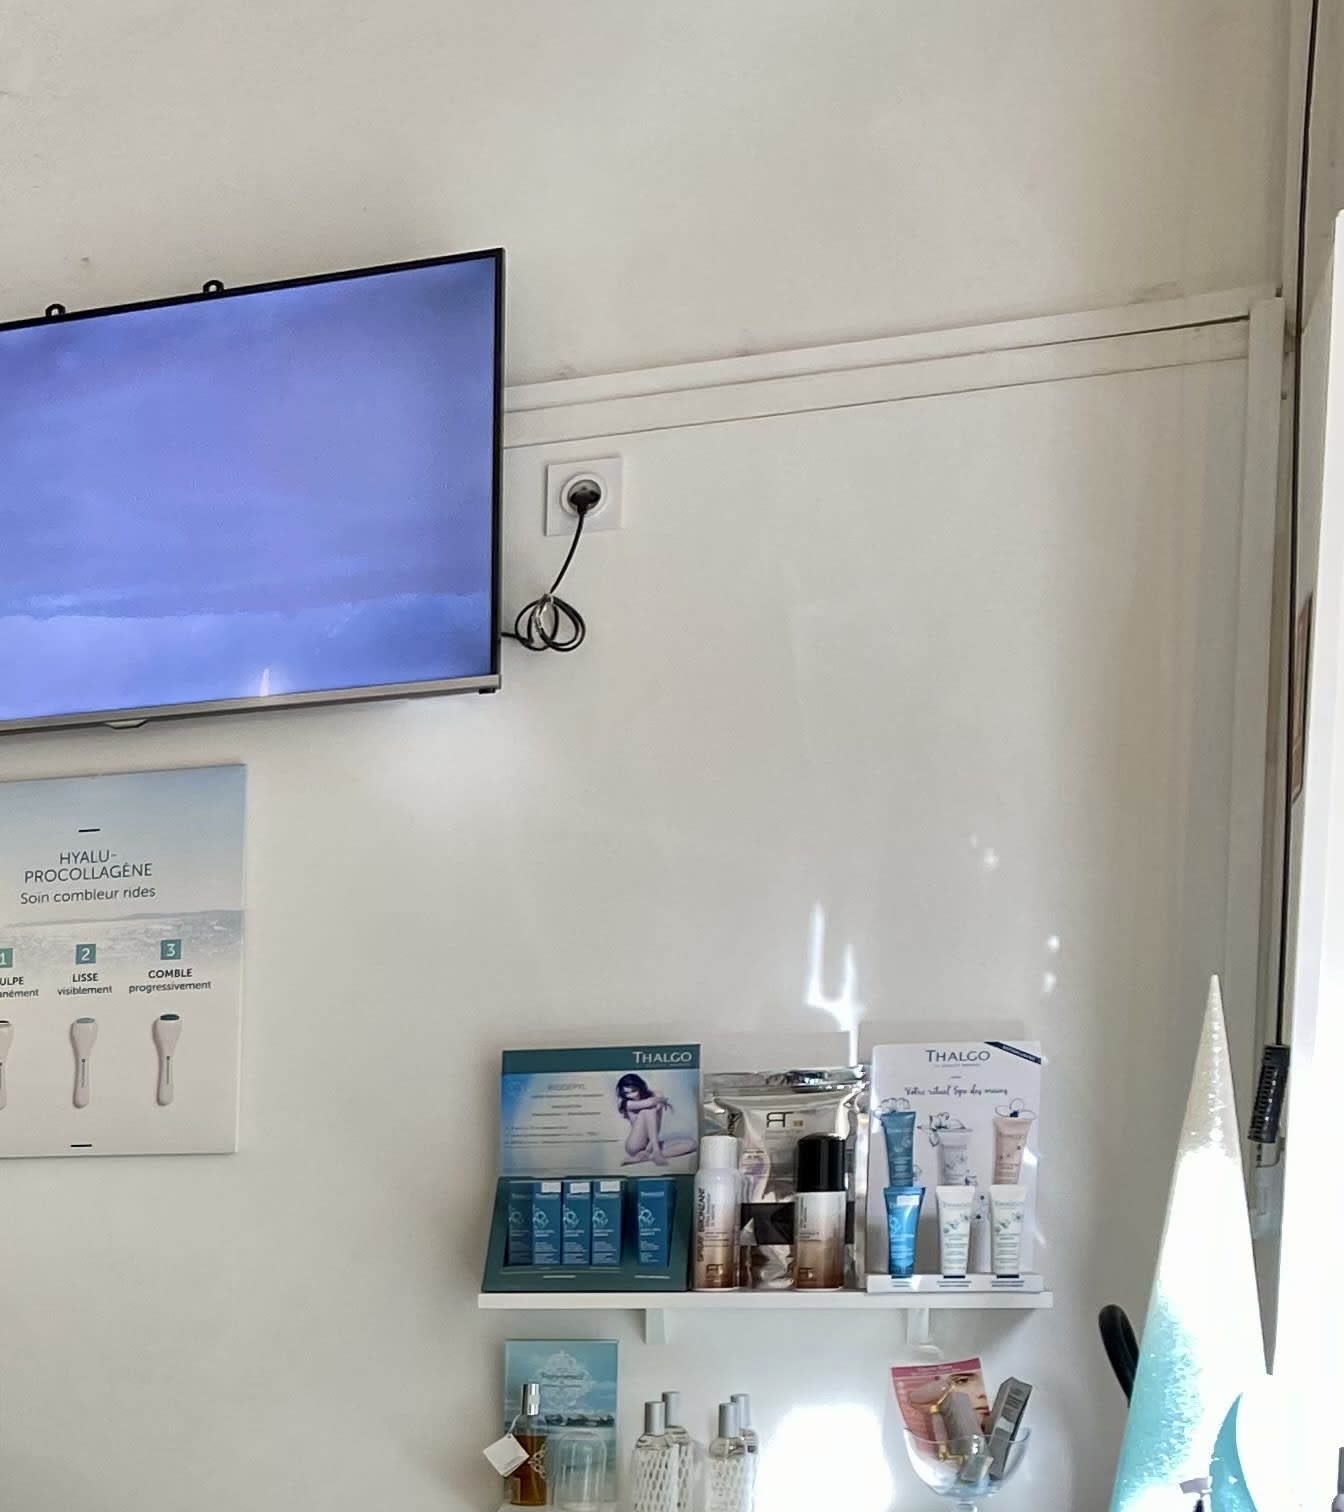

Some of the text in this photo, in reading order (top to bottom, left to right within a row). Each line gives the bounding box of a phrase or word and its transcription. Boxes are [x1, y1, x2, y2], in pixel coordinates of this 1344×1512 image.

[59, 850, 118, 865] HYALU-
[24, 862, 153, 883] PROCOLLAGÈNE
[20, 886, 156, 905] Soin combleur rides
[80, 947, 91, 962] 2
[165, 942, 176, 957] 3
[72, 972, 99, 983] LISSE
[148, 968, 193, 979] COMBLE
[57, 985, 113, 997] visiblement
[128, 980, 212, 994] progressivement
[632, 1050, 692, 1065] THALGO
[925, 1050, 991, 1063] THALGO
